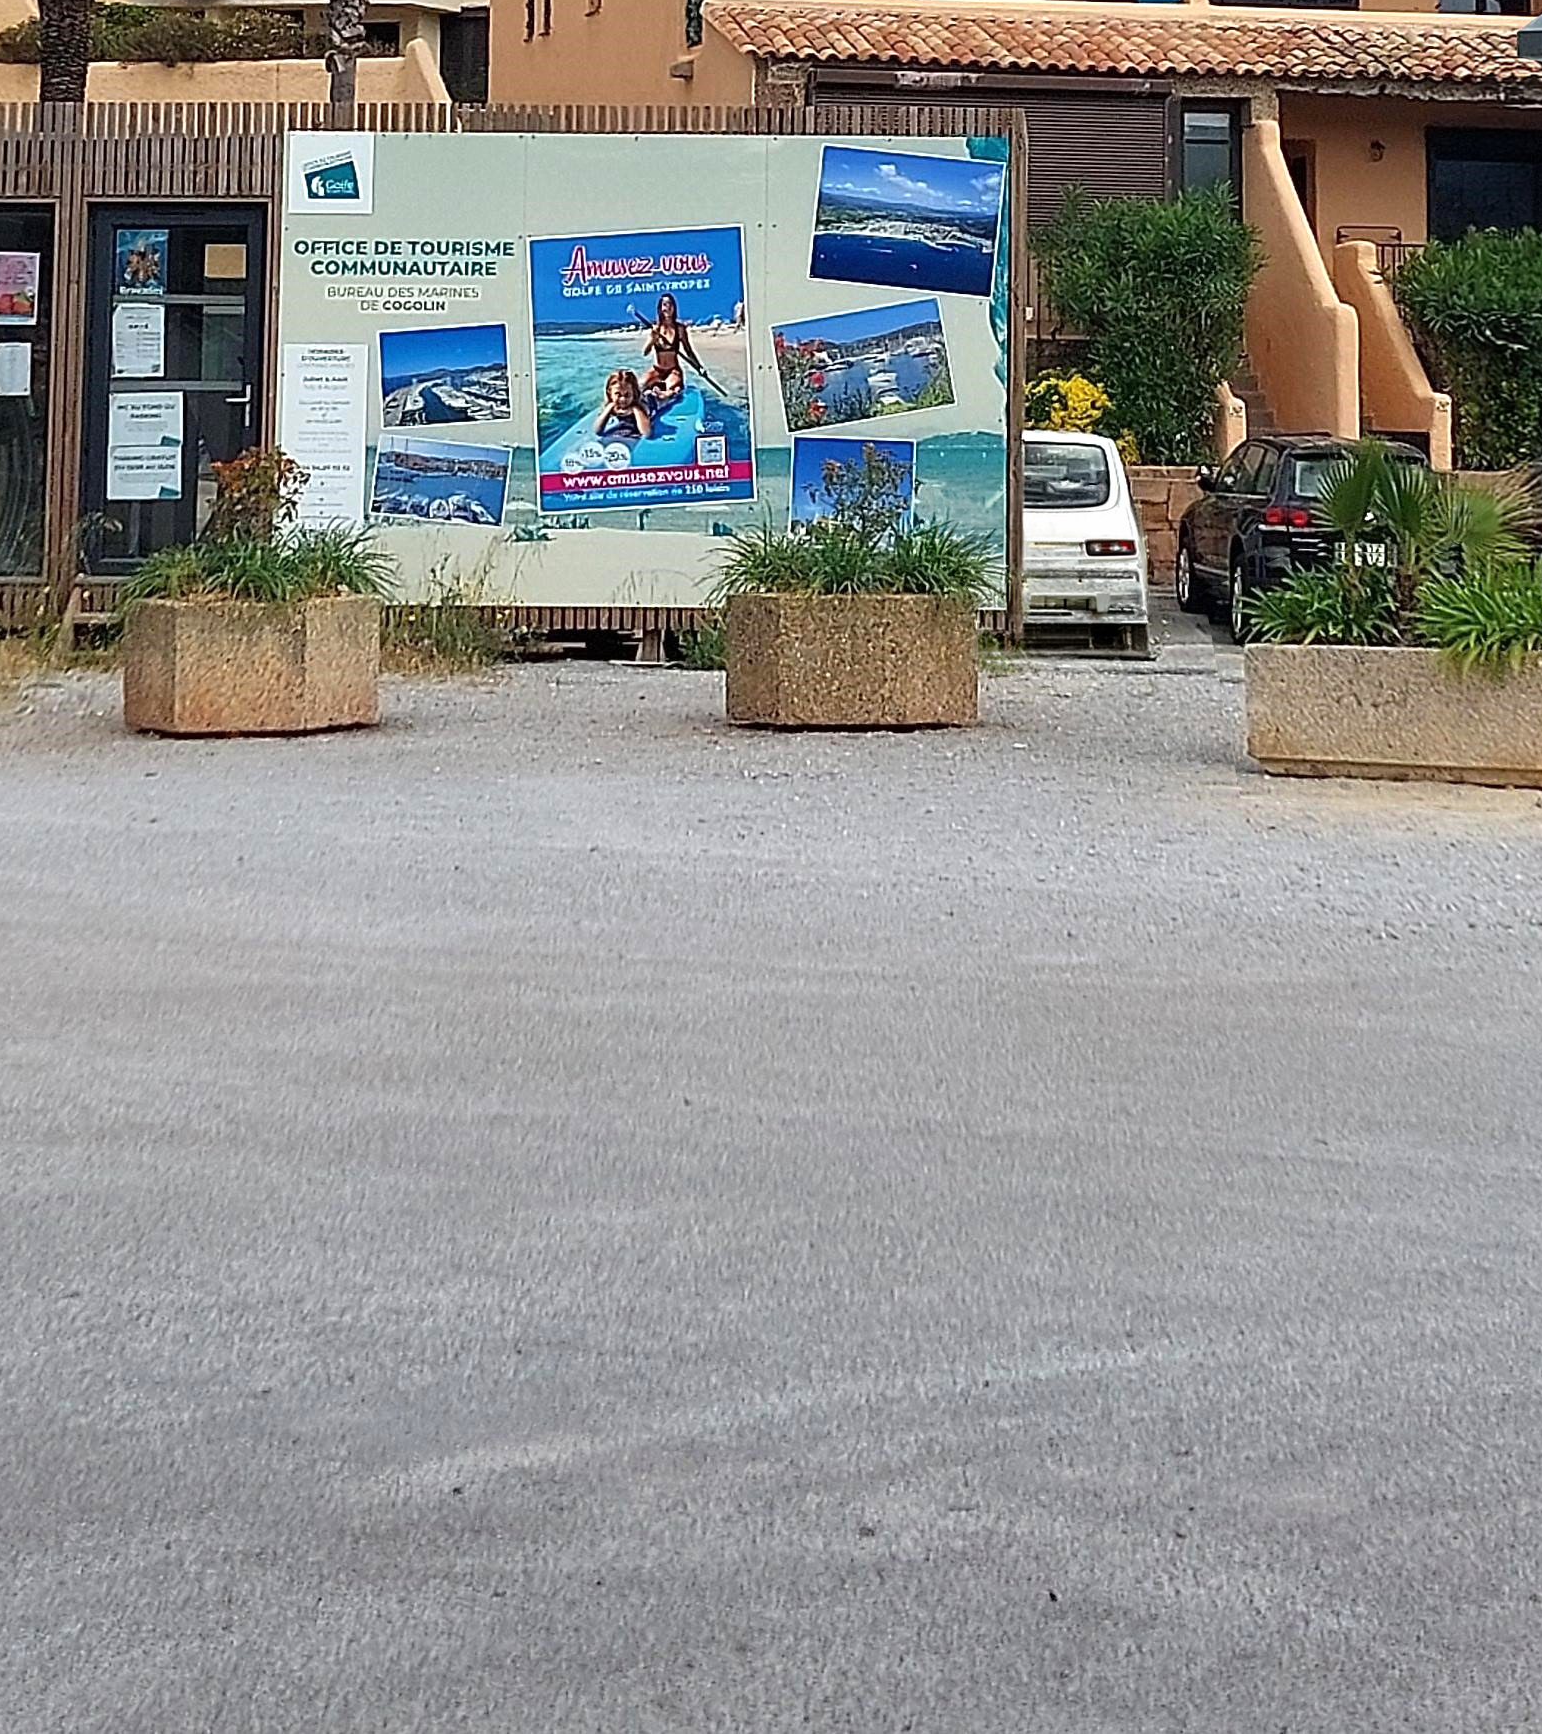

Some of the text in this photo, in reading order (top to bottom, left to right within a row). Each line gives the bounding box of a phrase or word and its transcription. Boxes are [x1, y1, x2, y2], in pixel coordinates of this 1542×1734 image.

[294, 240, 515, 256] OFFICE DE TOURISME
[310, 260, 497, 277] COMMUNAUTAIRE
[327, 286, 479, 298] BUREAU DES MARINES
[563, 284, 602, 297] GOLFE
[606, 283, 622, 295] DE
[359, 300, 447, 311] DE COGOLIN
[562, 465, 729, 487] www.amusezvous.net
